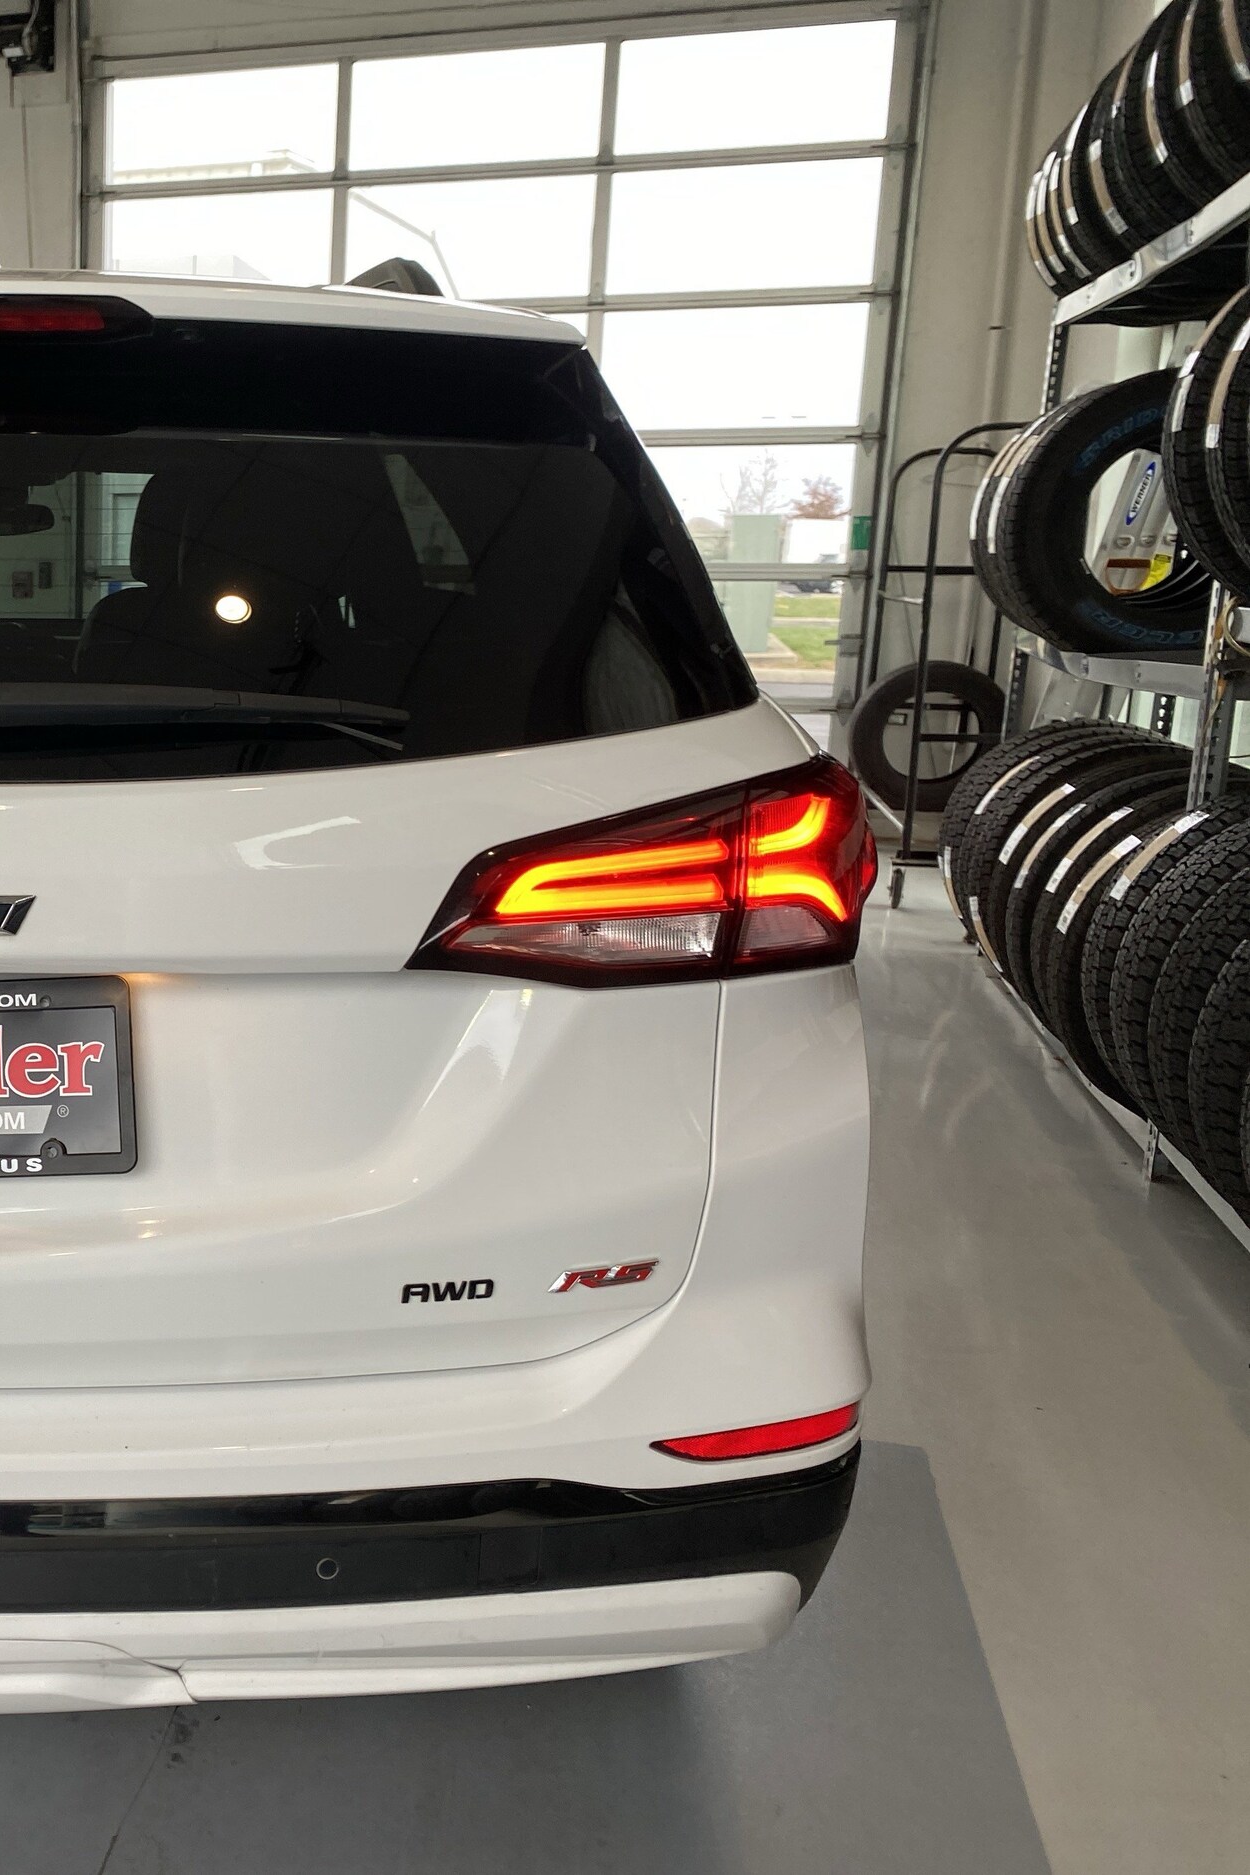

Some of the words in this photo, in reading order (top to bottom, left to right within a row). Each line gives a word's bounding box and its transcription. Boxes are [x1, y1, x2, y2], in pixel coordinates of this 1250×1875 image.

[1129, 473, 1152, 513] WERNER
[400, 1278, 494, 1304] AWD
[547, 1257, 659, 1293] RS
